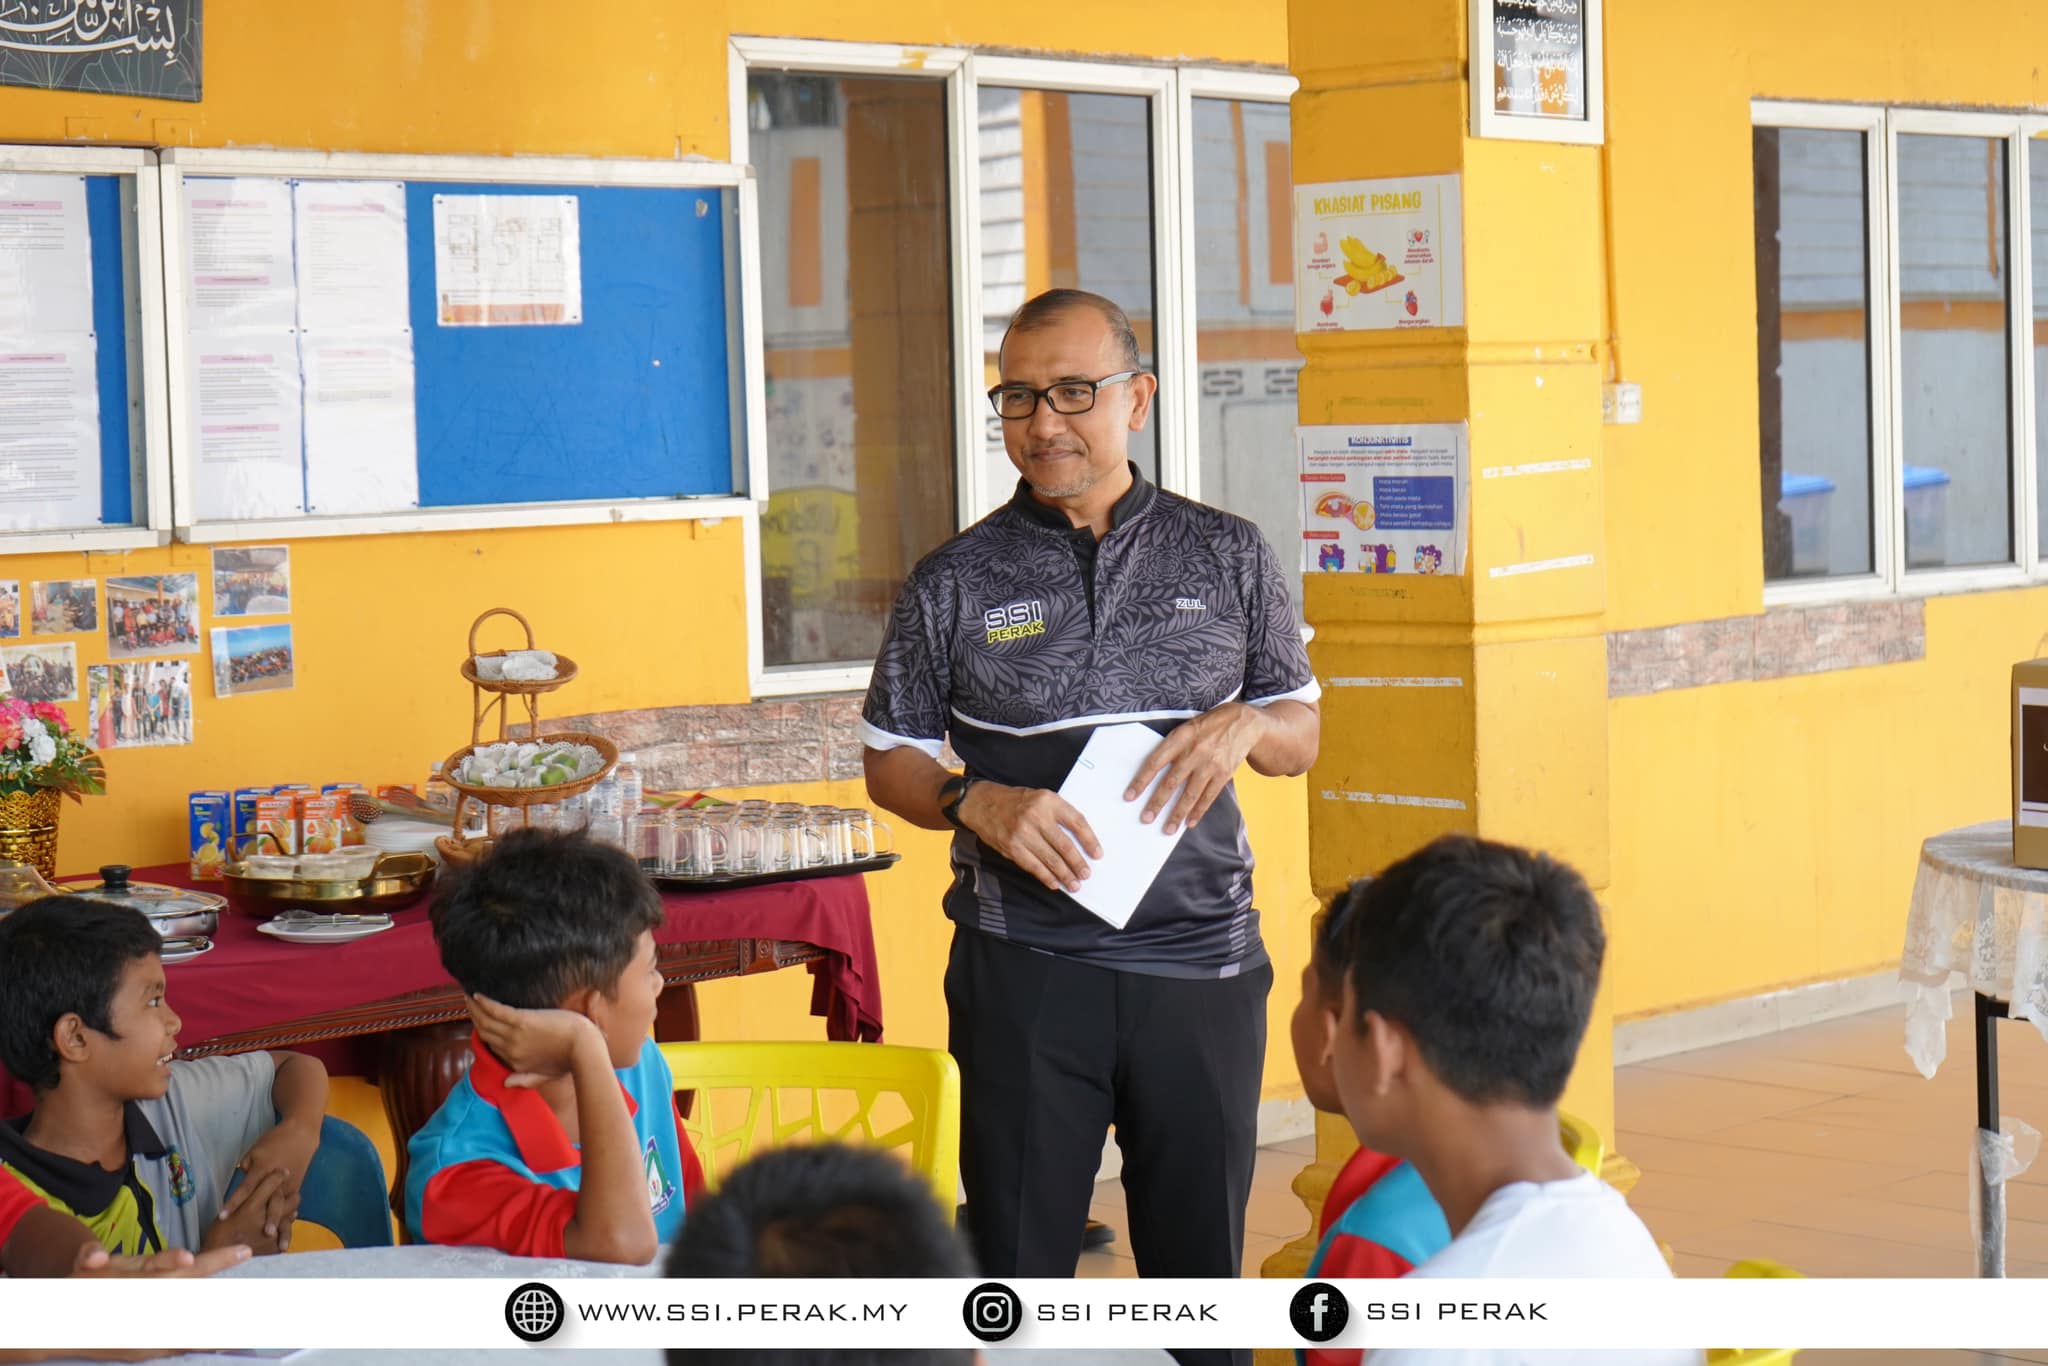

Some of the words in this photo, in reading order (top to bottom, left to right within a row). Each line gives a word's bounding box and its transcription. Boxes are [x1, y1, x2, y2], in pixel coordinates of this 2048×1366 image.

[1313, 194, 1366, 216] KHASIAT
[1371, 191, 1422, 211] PISANG
[985, 600, 1042, 630] SSI
[1176, 598, 1206, 610] ZUL
[987, 621, 1046, 643] PERAK
